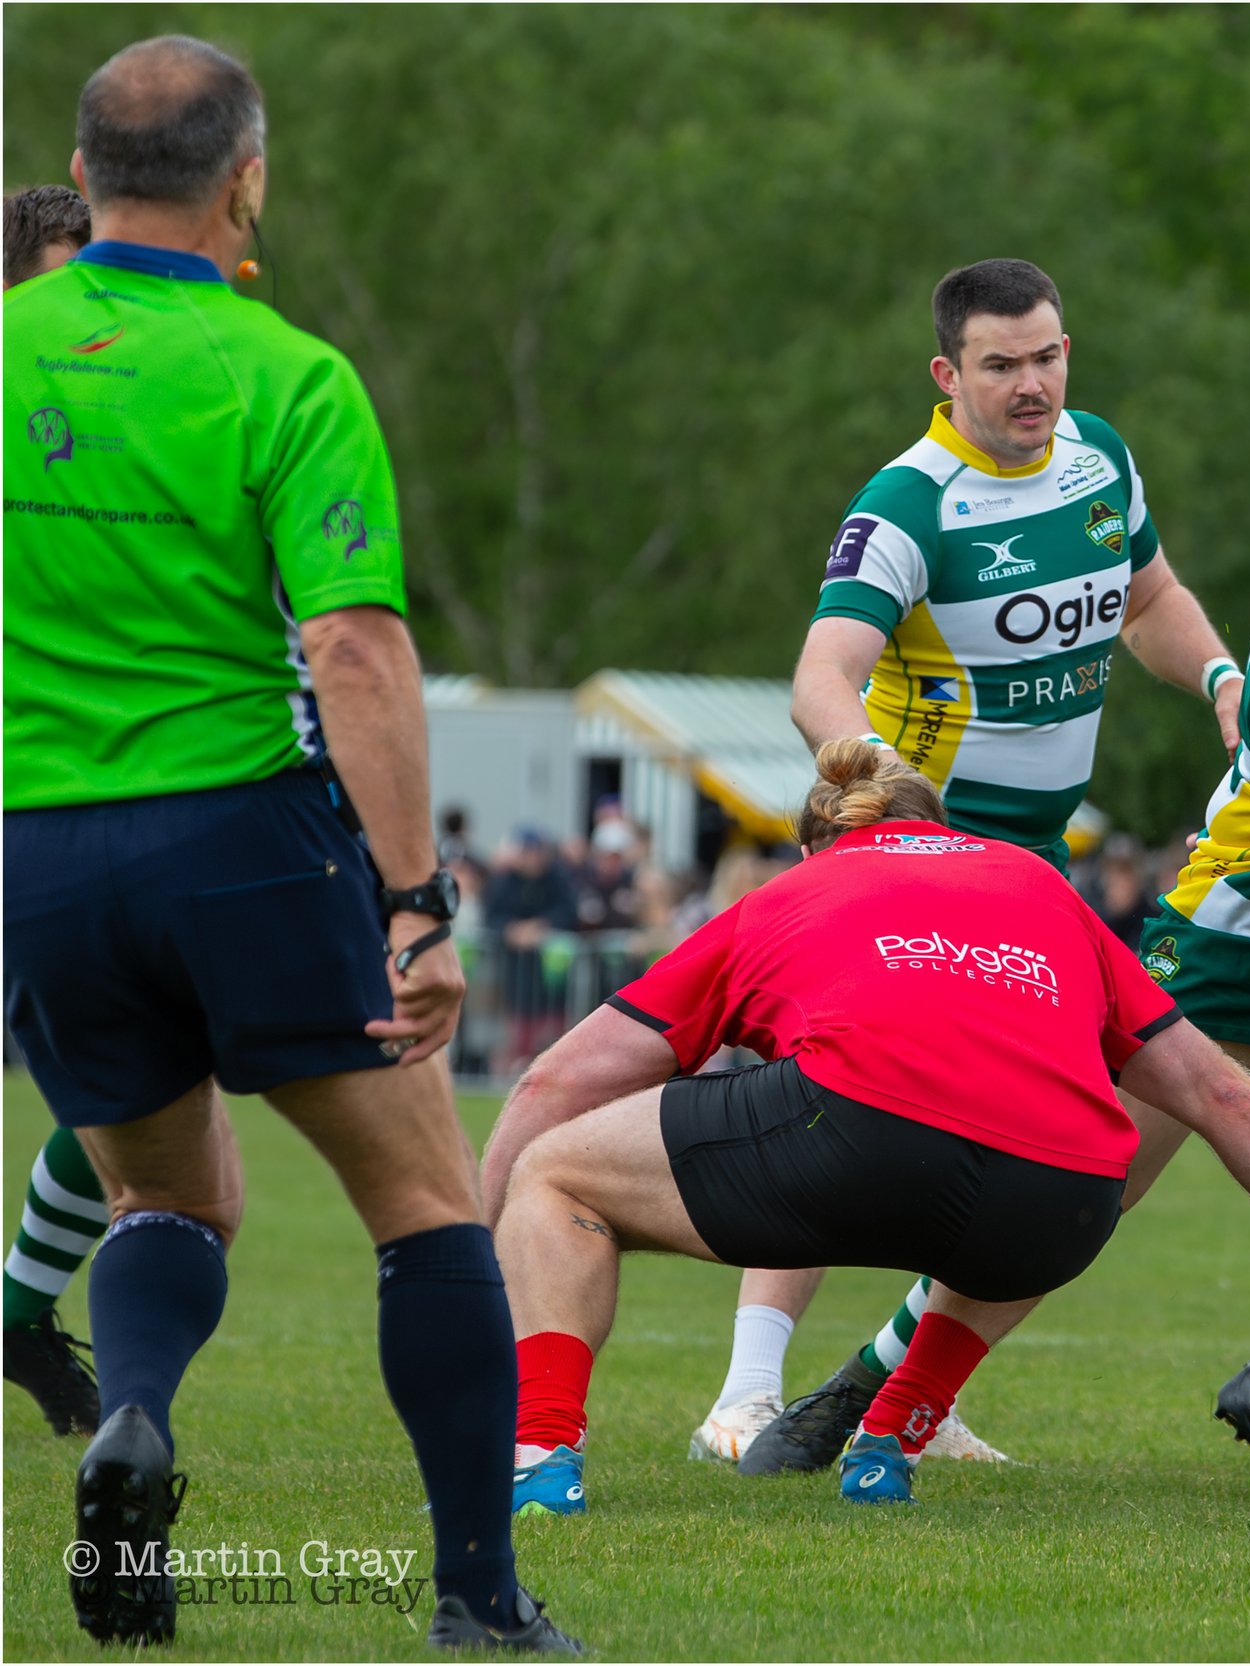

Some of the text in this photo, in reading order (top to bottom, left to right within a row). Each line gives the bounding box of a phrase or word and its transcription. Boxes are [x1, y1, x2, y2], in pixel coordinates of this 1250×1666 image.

[977, 562, 1037, 583] GILBERT
[874, 931, 1059, 988] Polygon
[886, 960, 1060, 1007] COLLECTIVE
